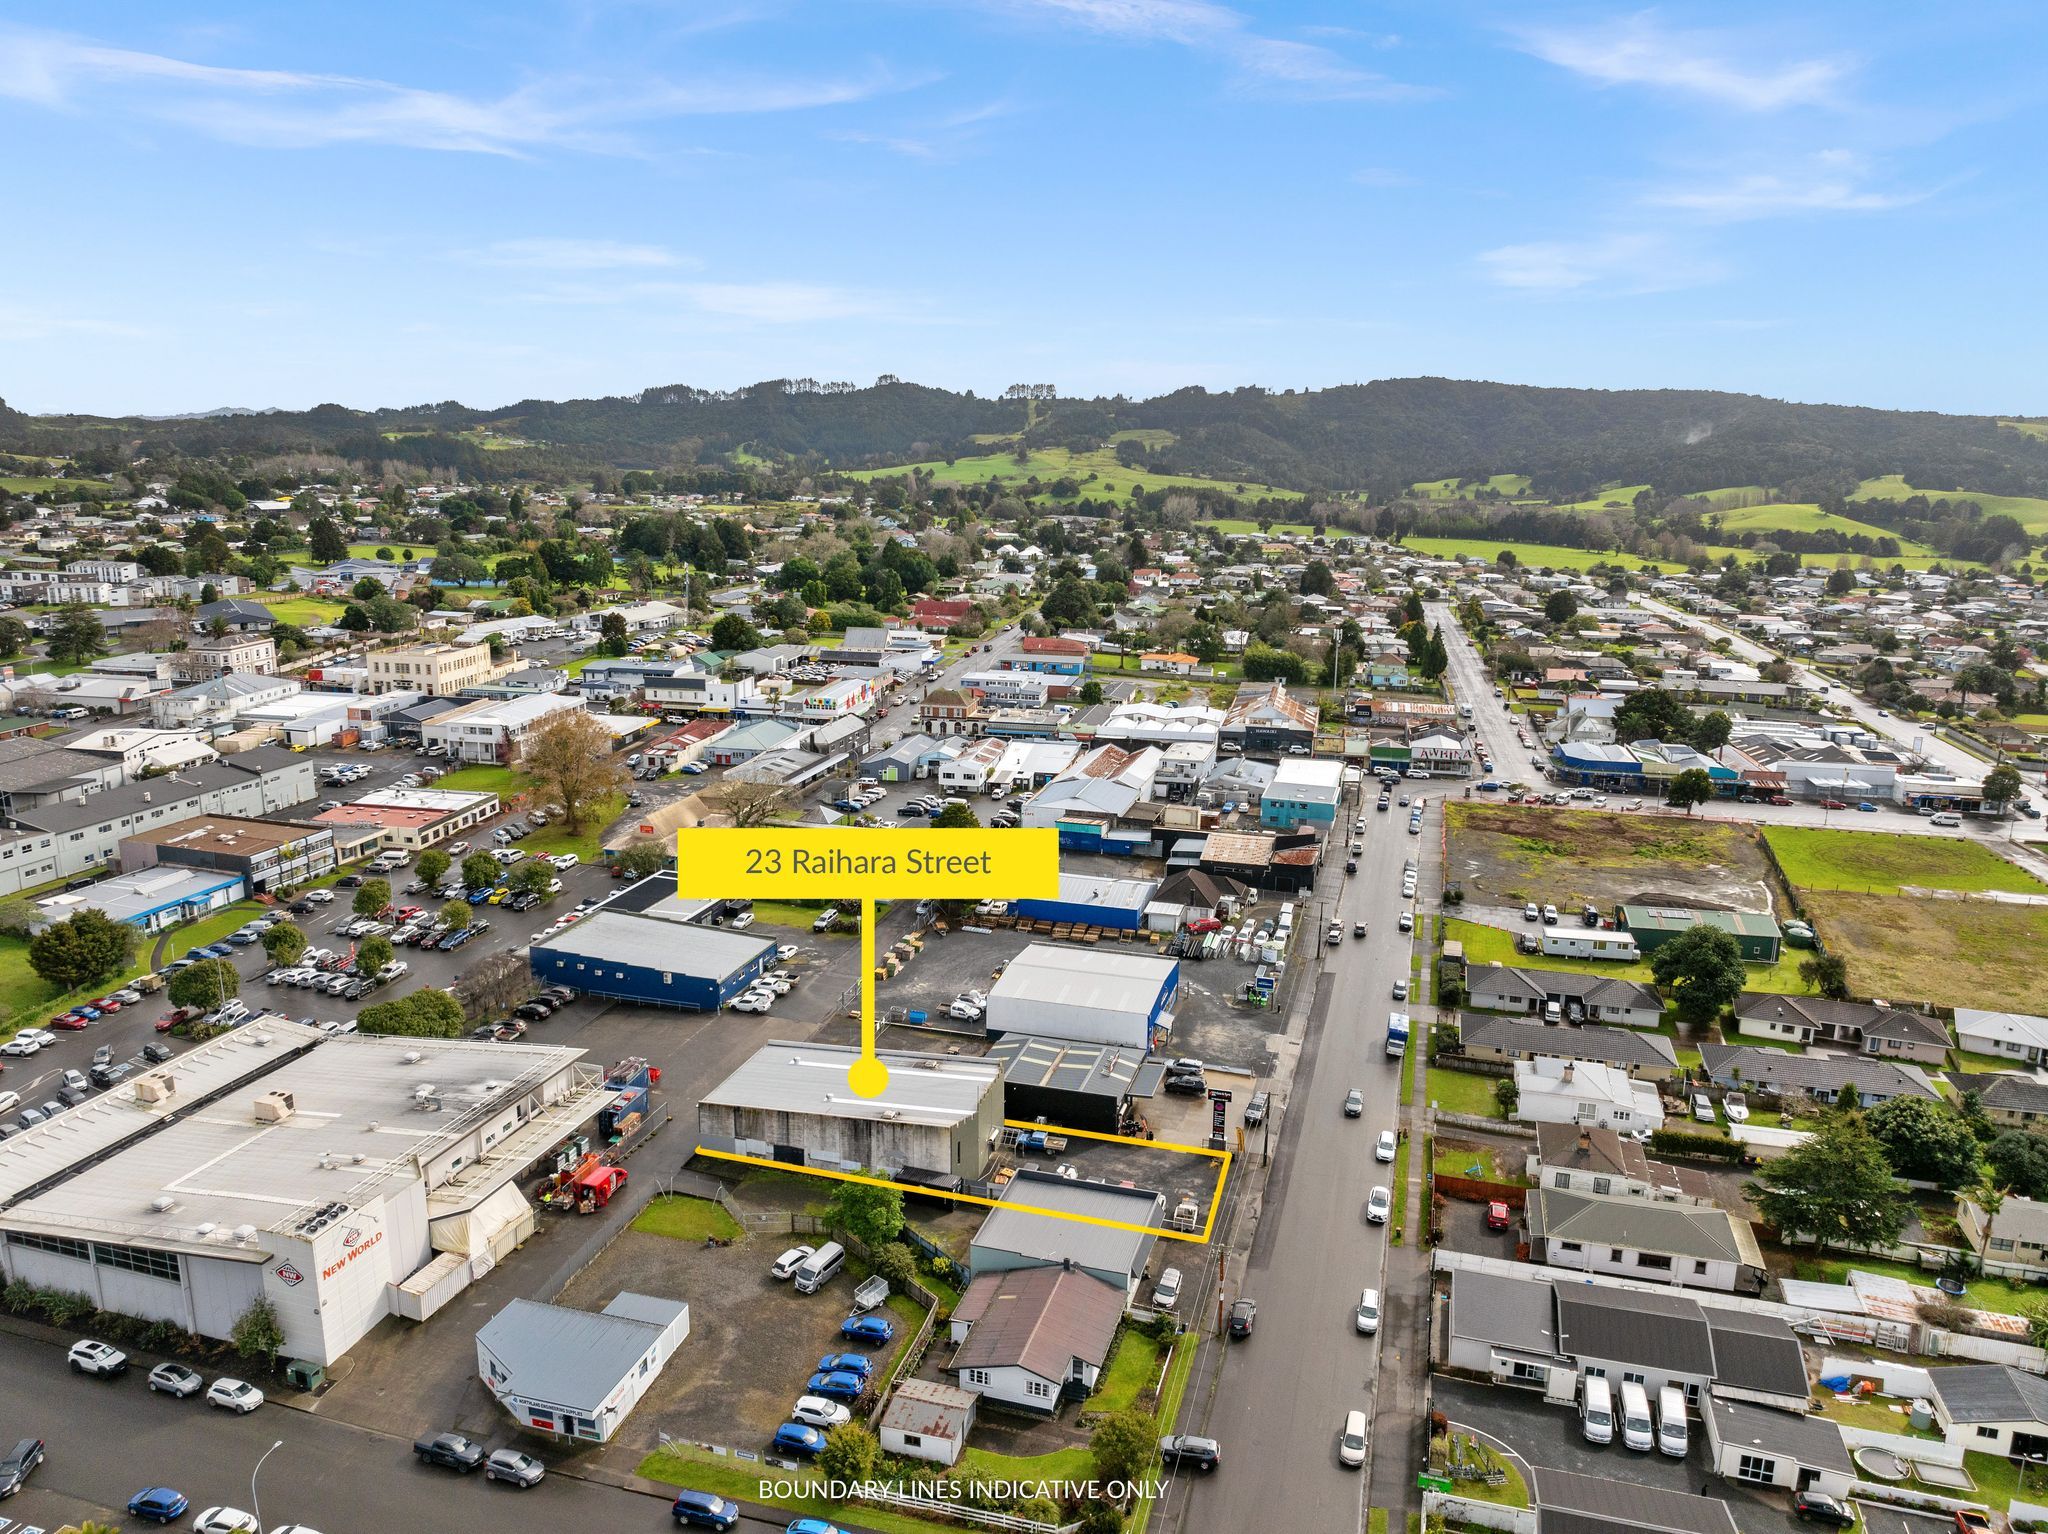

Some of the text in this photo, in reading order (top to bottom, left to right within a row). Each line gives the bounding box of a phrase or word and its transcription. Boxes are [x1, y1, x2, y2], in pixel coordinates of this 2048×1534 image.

[1421, 748, 1472, 760] AWHINA
[322, 1231, 383, 1280] NEW WORLD
[282, 1270, 297, 1280] NW
[519, 1399, 583, 1417] NORTHLAND ENGINEERING SUPPLIES
